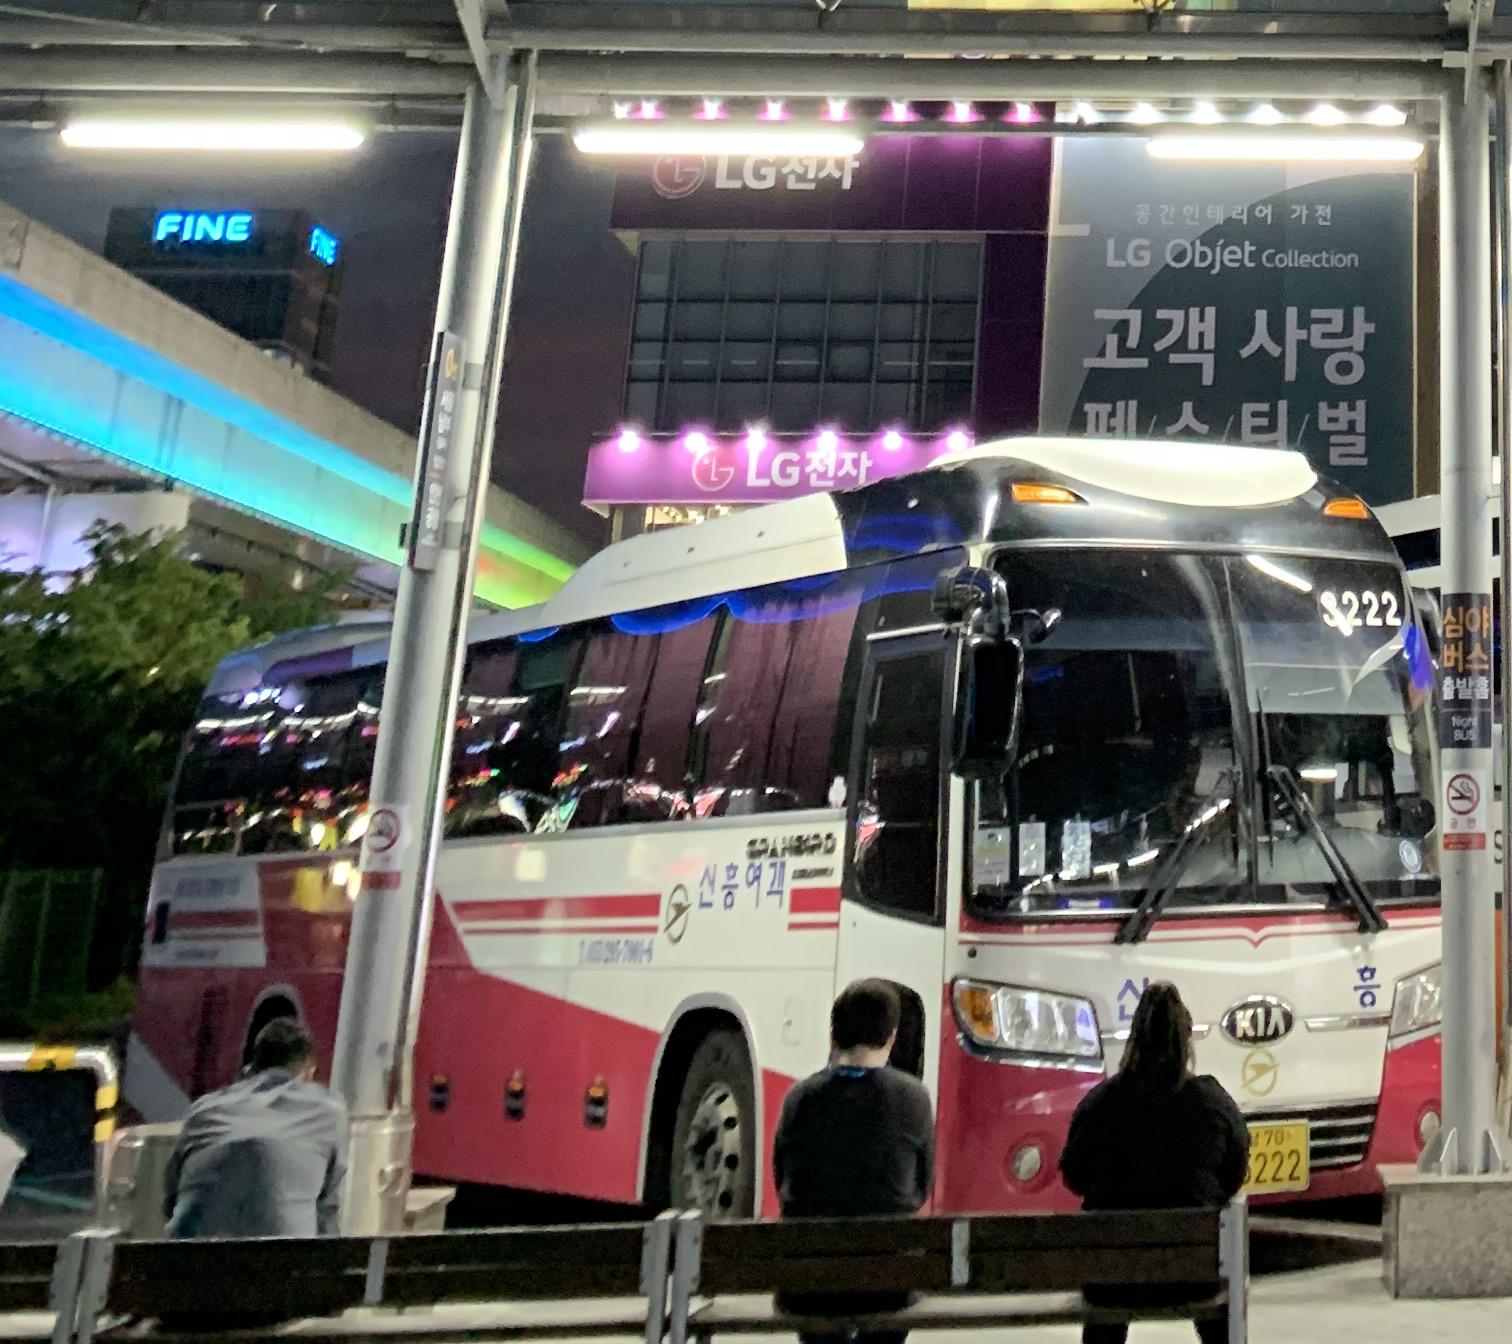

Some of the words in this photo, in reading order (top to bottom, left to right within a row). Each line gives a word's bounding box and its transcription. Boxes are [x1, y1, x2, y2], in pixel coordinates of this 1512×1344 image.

[154, 214, 252, 241] FINE
[1136, 204, 1273, 226] 공간인테리어
[1290, 204, 1332, 226] 가전
[309, 226, 338, 265] FINE
[1106, 238, 1151, 268] LG
[1164, 238, 1256, 275] Objet
[1262, 249, 1359, 268] Collection
[1083, 306, 1216, 386] 고객
[1239, 306, 1376, 385] 사랑
[746, 447, 873, 488] LG전자
[1444, 606, 1490, 639] 심야
[1443, 641, 1490, 672] 버스
[698, 860, 787, 911] 신흥여객
